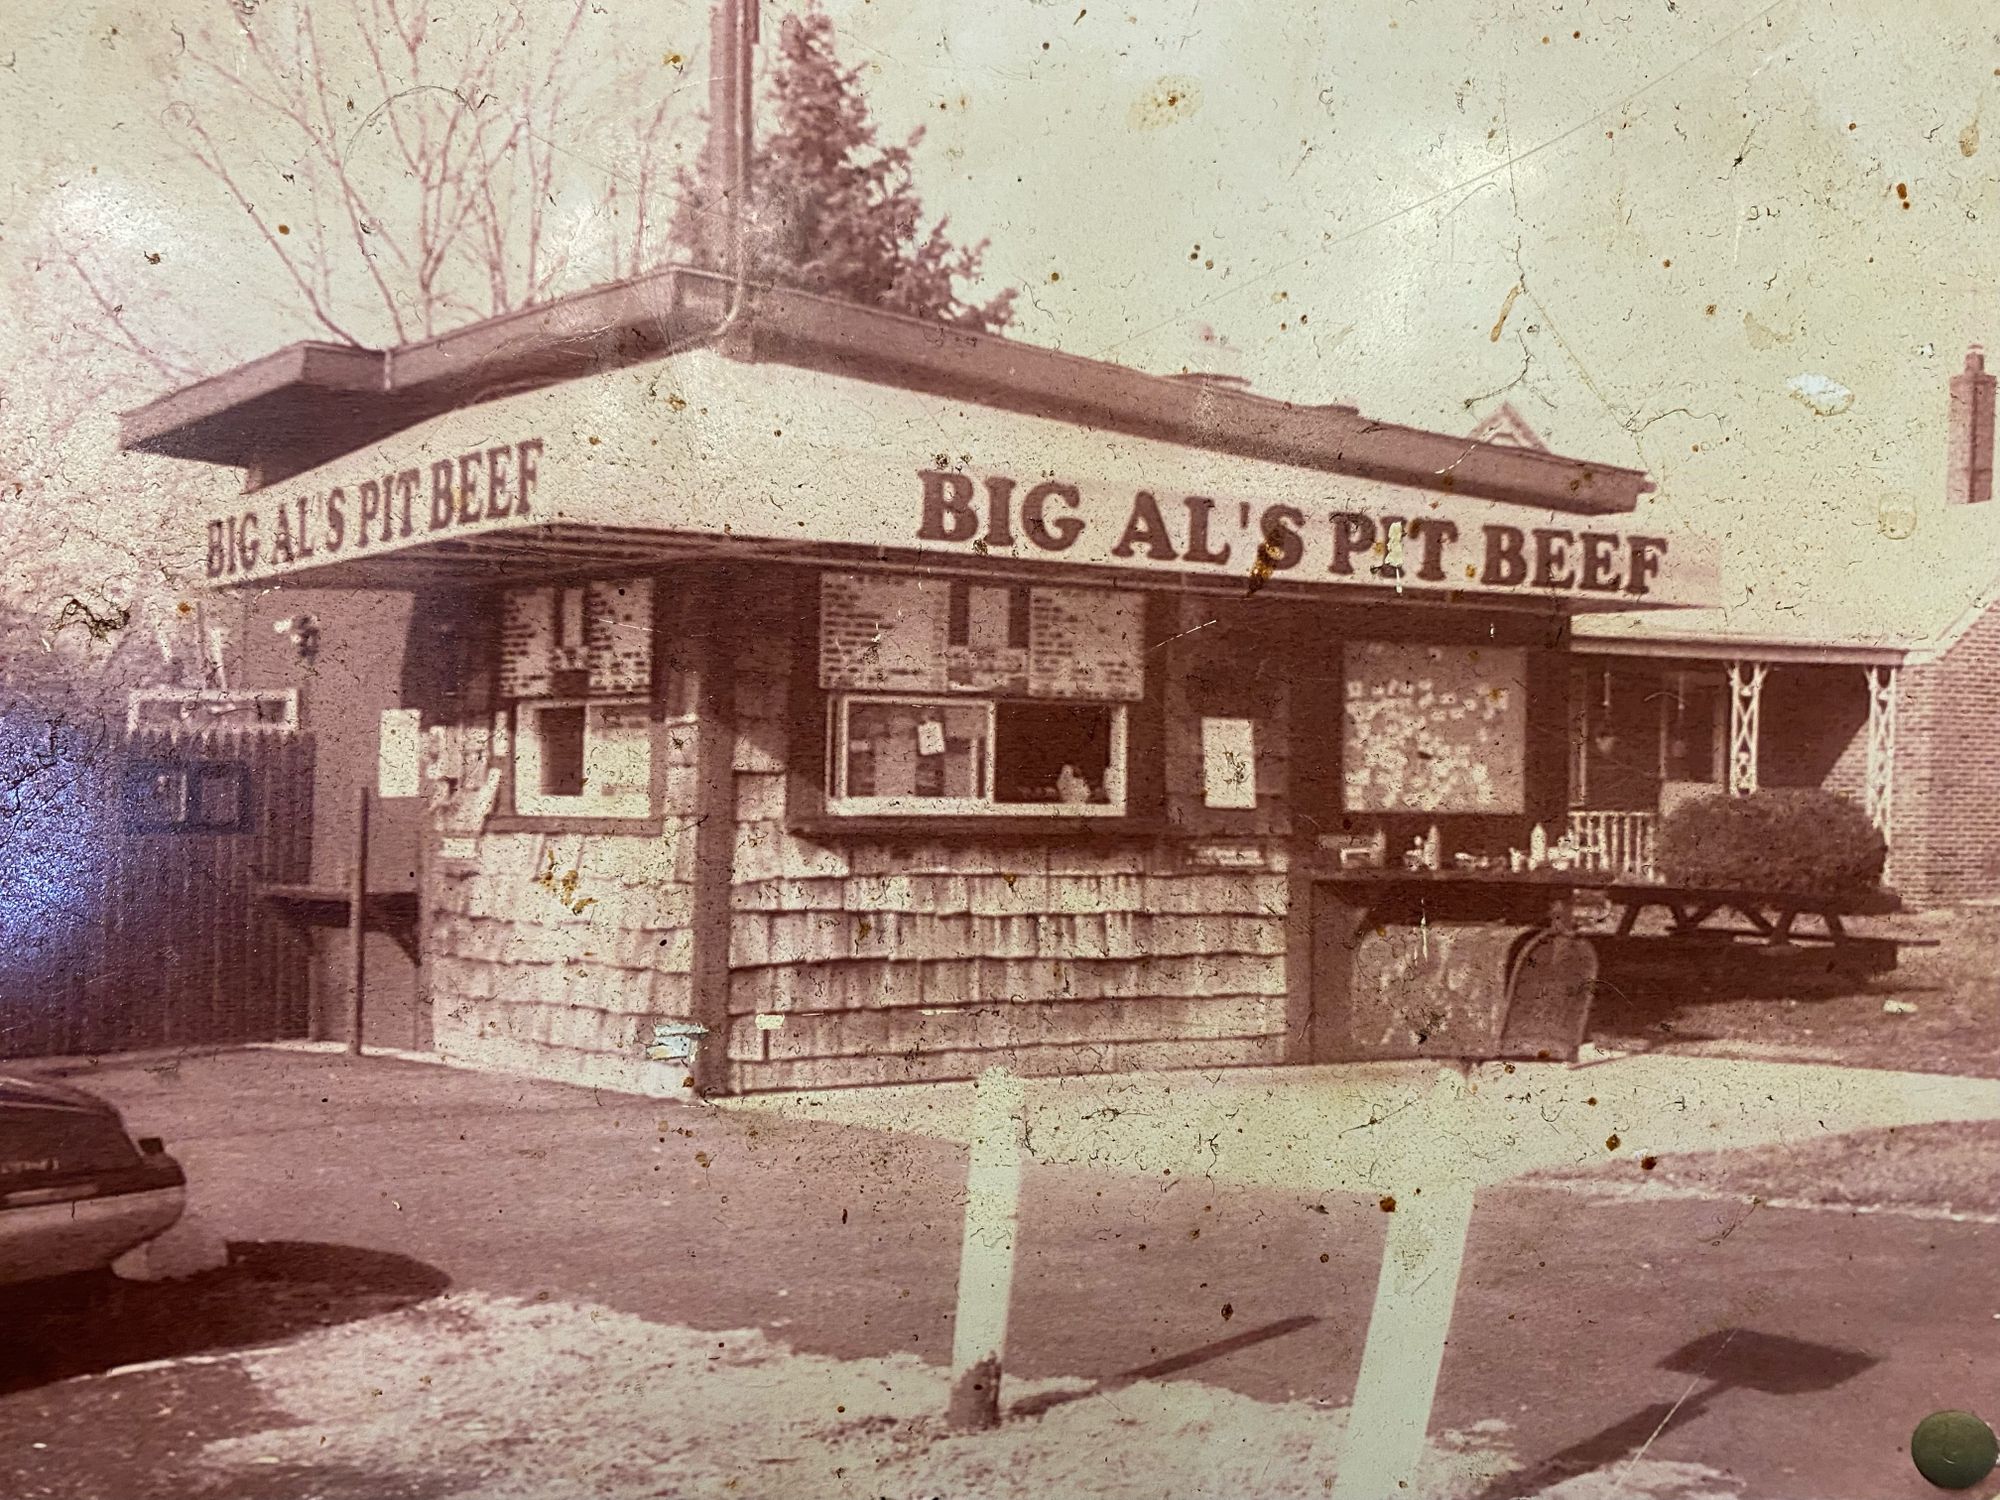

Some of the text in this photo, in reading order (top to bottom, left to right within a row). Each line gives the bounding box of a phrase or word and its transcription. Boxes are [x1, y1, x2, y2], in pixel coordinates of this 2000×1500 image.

[207, 438, 544, 578] BIG AL'S PIT BEEF
[917, 468, 1668, 595] BIG AL'S PIT BEEF
